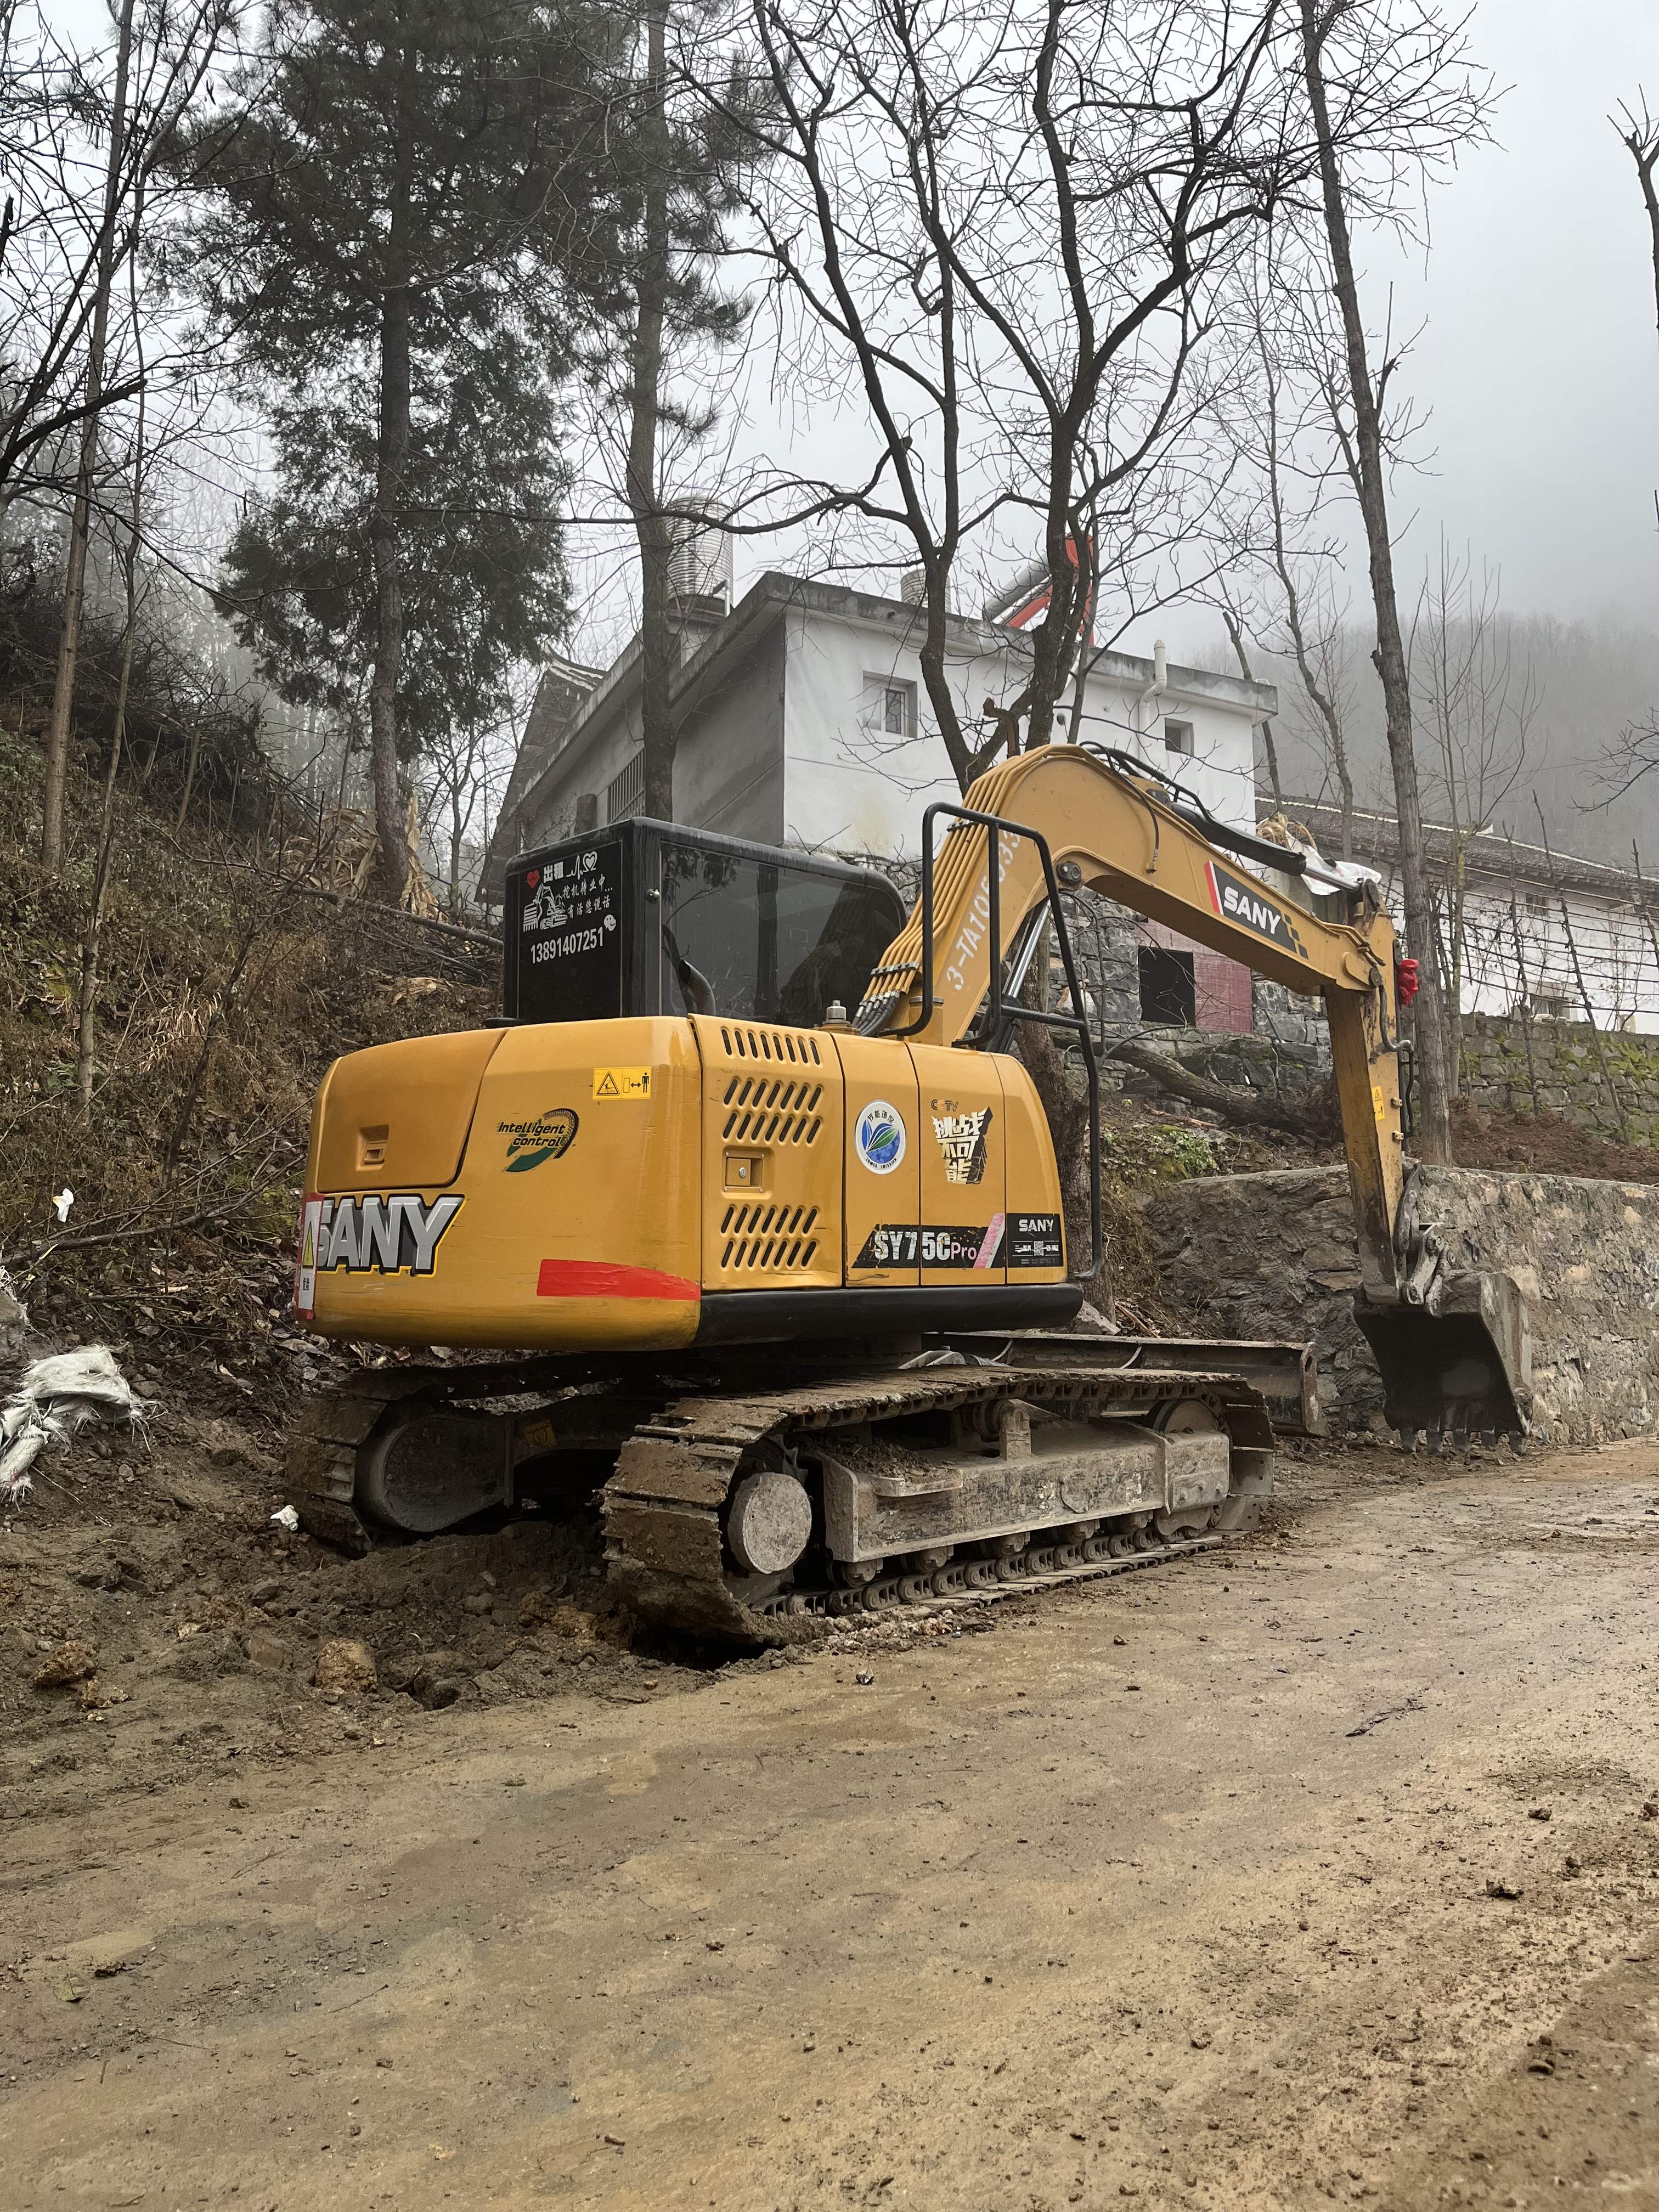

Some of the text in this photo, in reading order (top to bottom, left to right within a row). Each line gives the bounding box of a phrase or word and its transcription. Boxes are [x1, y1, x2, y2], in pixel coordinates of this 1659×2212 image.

[544, 861, 563, 883] 出租
[1223, 886, 1280, 934] SANY
[531, 927, 603, 963] 13891407251
[930, 1099, 959, 1112] CCTV
[867, 1110, 895, 1124] 节能环保
[932, 1108, 988, 1138] 挑战
[498, 1122, 566, 1136] Intelligent
[513, 1136, 562, 1147] control
[944, 1158, 972, 1184] 能
[1019, 1219, 1054, 1232] SANY
